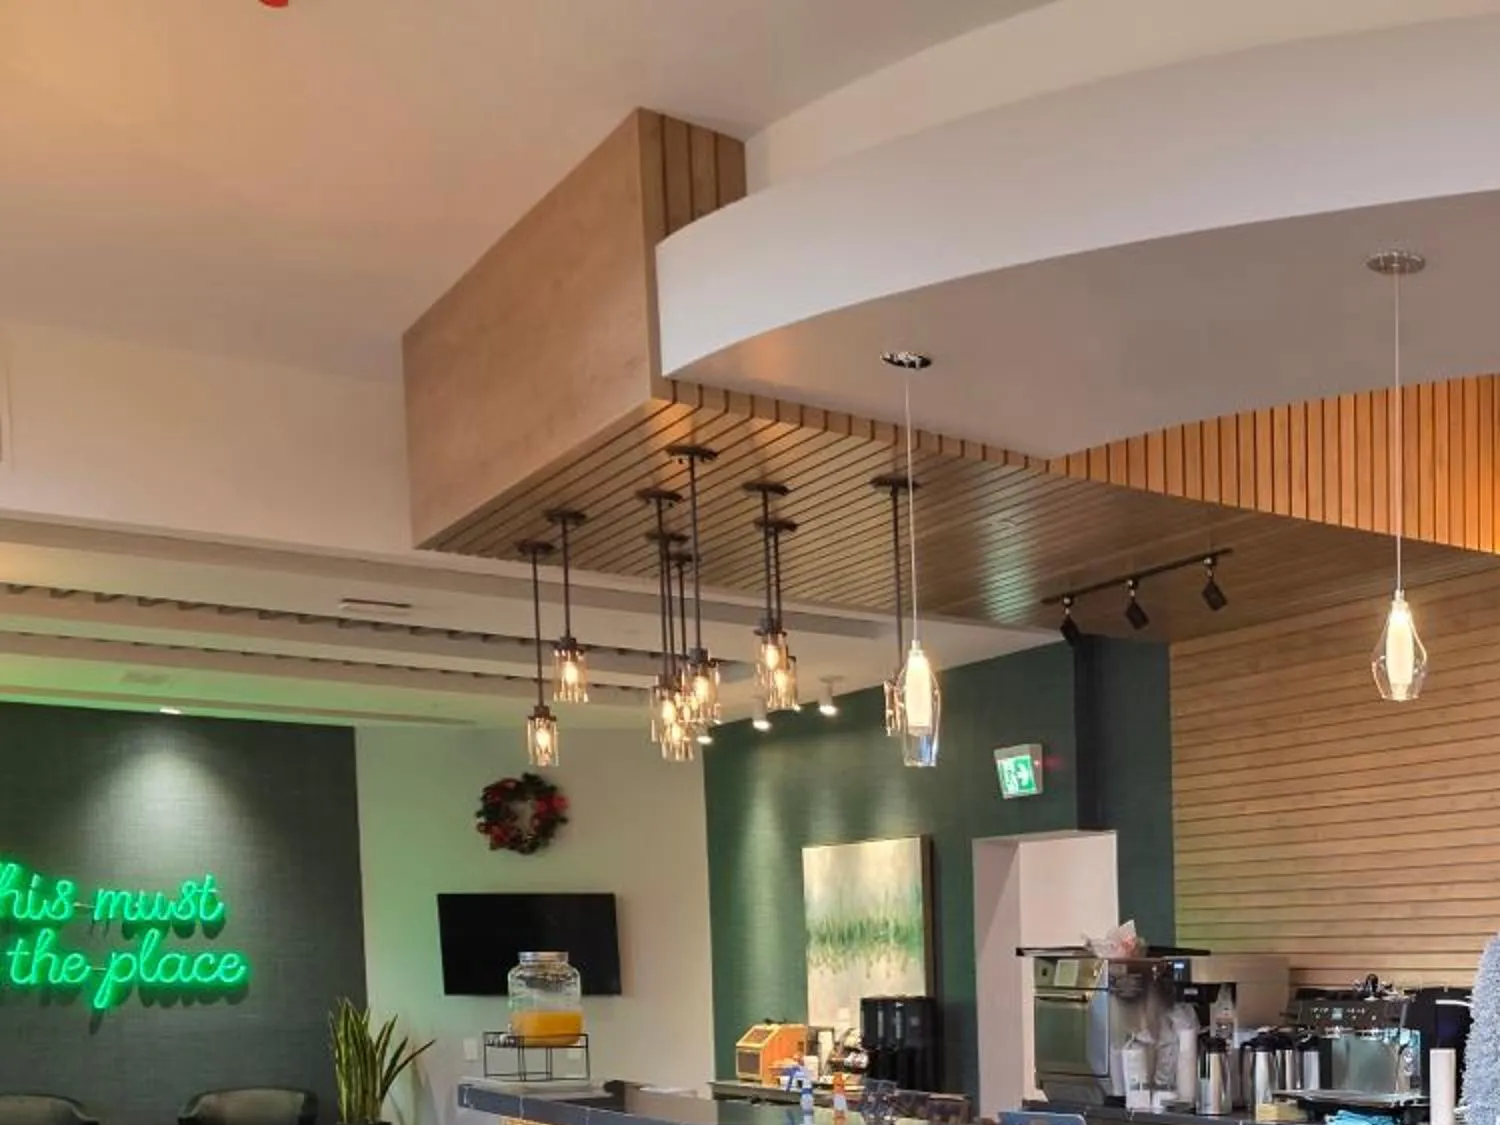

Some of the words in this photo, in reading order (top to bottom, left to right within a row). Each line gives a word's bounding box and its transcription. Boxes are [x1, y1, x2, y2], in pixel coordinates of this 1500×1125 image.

[94, 874, 224, 920] must
[6, 928, 92, 984] the
[93, 928, 248, 1009] place
